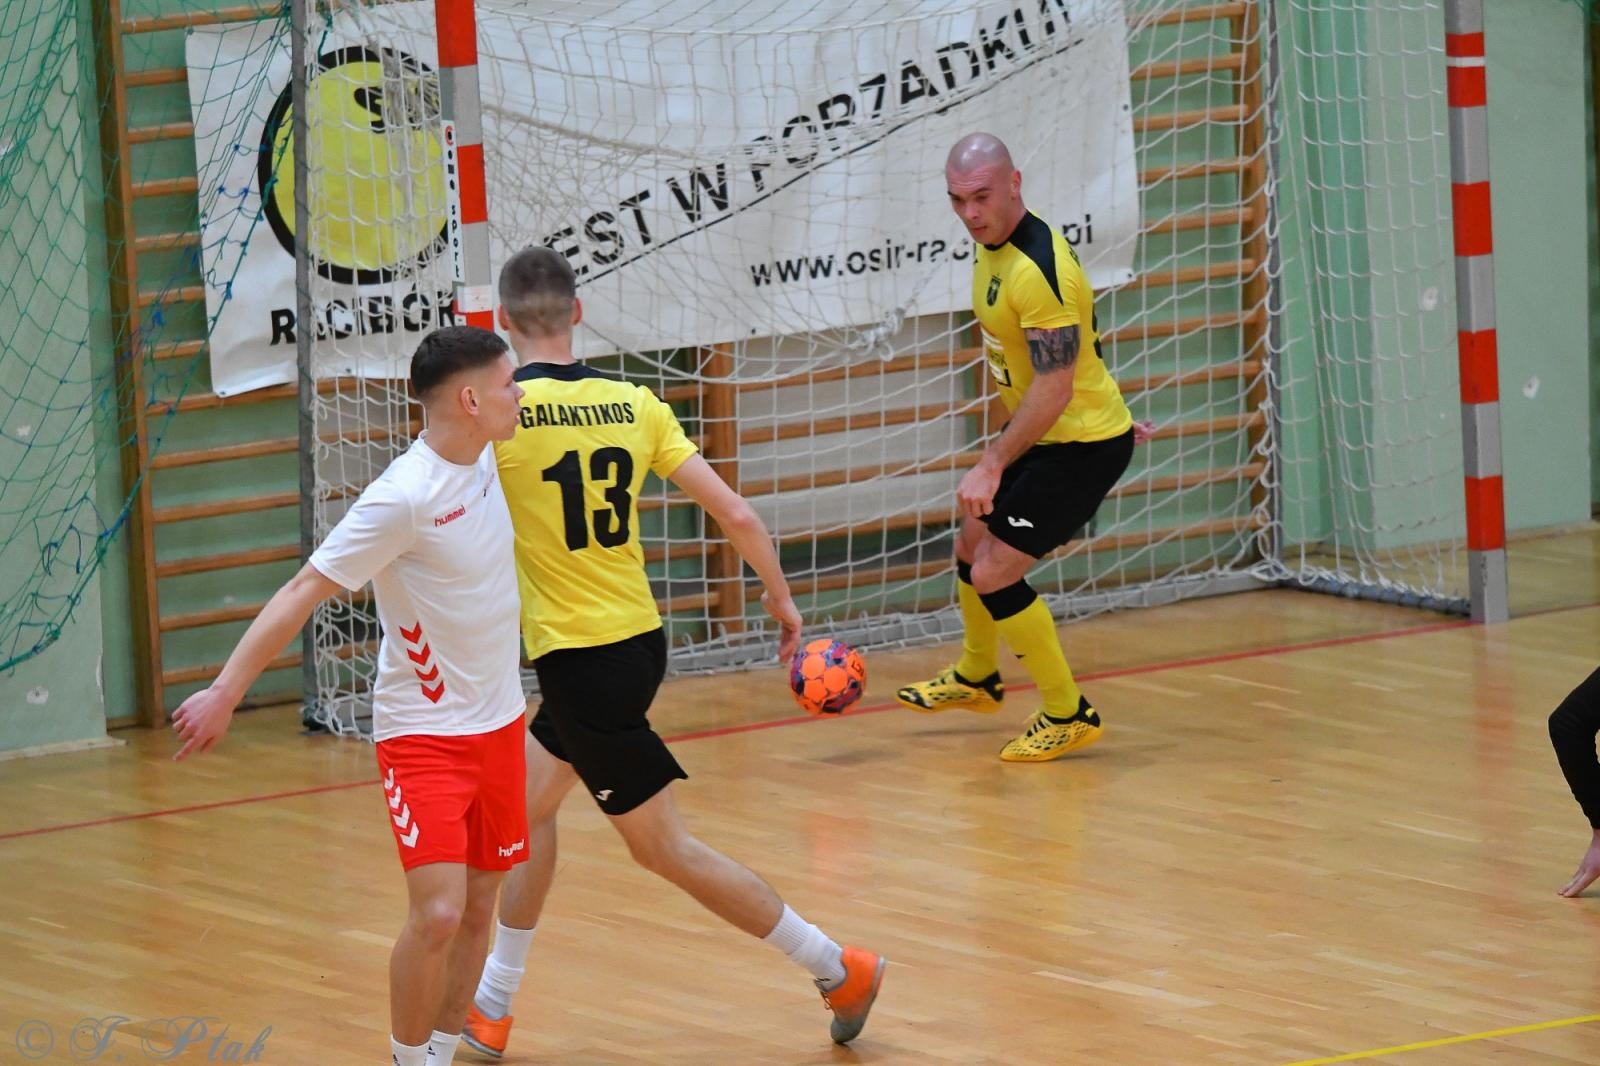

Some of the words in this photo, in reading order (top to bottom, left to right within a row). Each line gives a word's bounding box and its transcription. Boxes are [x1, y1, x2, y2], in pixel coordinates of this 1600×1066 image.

[528, 189, 652, 276] EST
[665, 163, 729, 223] W
[519, 402, 635, 429] GALAKTIKOS
[434, 504, 466, 528] hummel
[541, 446, 634, 552] 13
